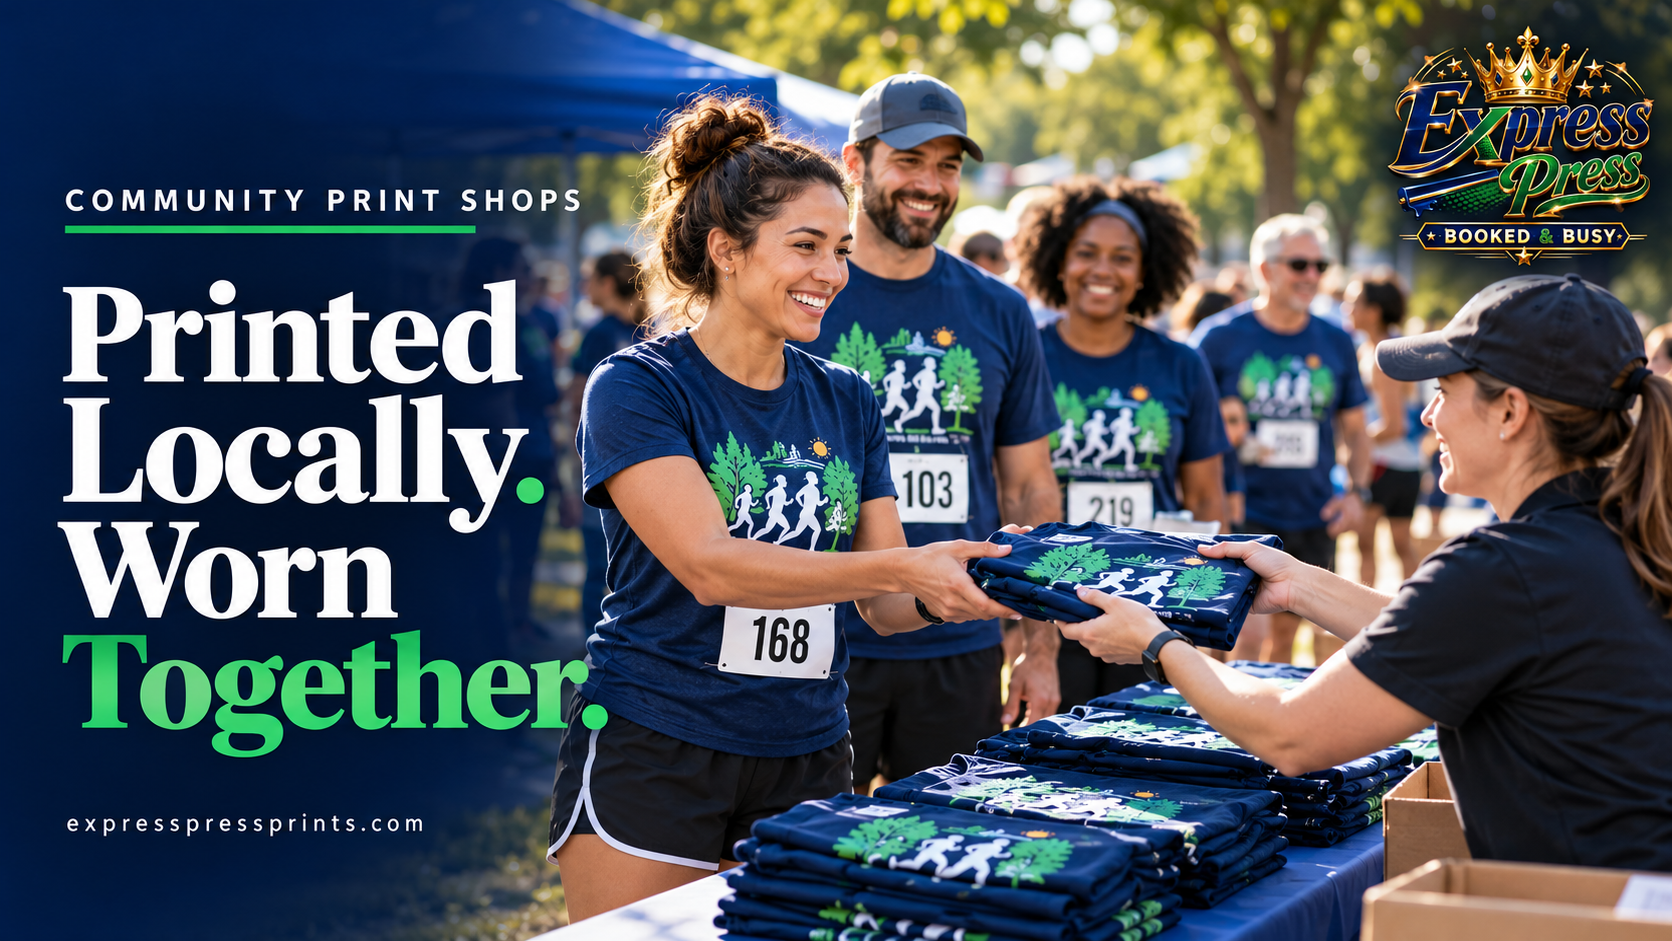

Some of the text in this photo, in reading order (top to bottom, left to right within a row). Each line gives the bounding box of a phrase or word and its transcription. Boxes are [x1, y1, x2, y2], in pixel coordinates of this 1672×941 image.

[902, 470, 953, 509] 103
[1090, 496, 1134, 527] 219
[753, 615, 810, 664] 168
